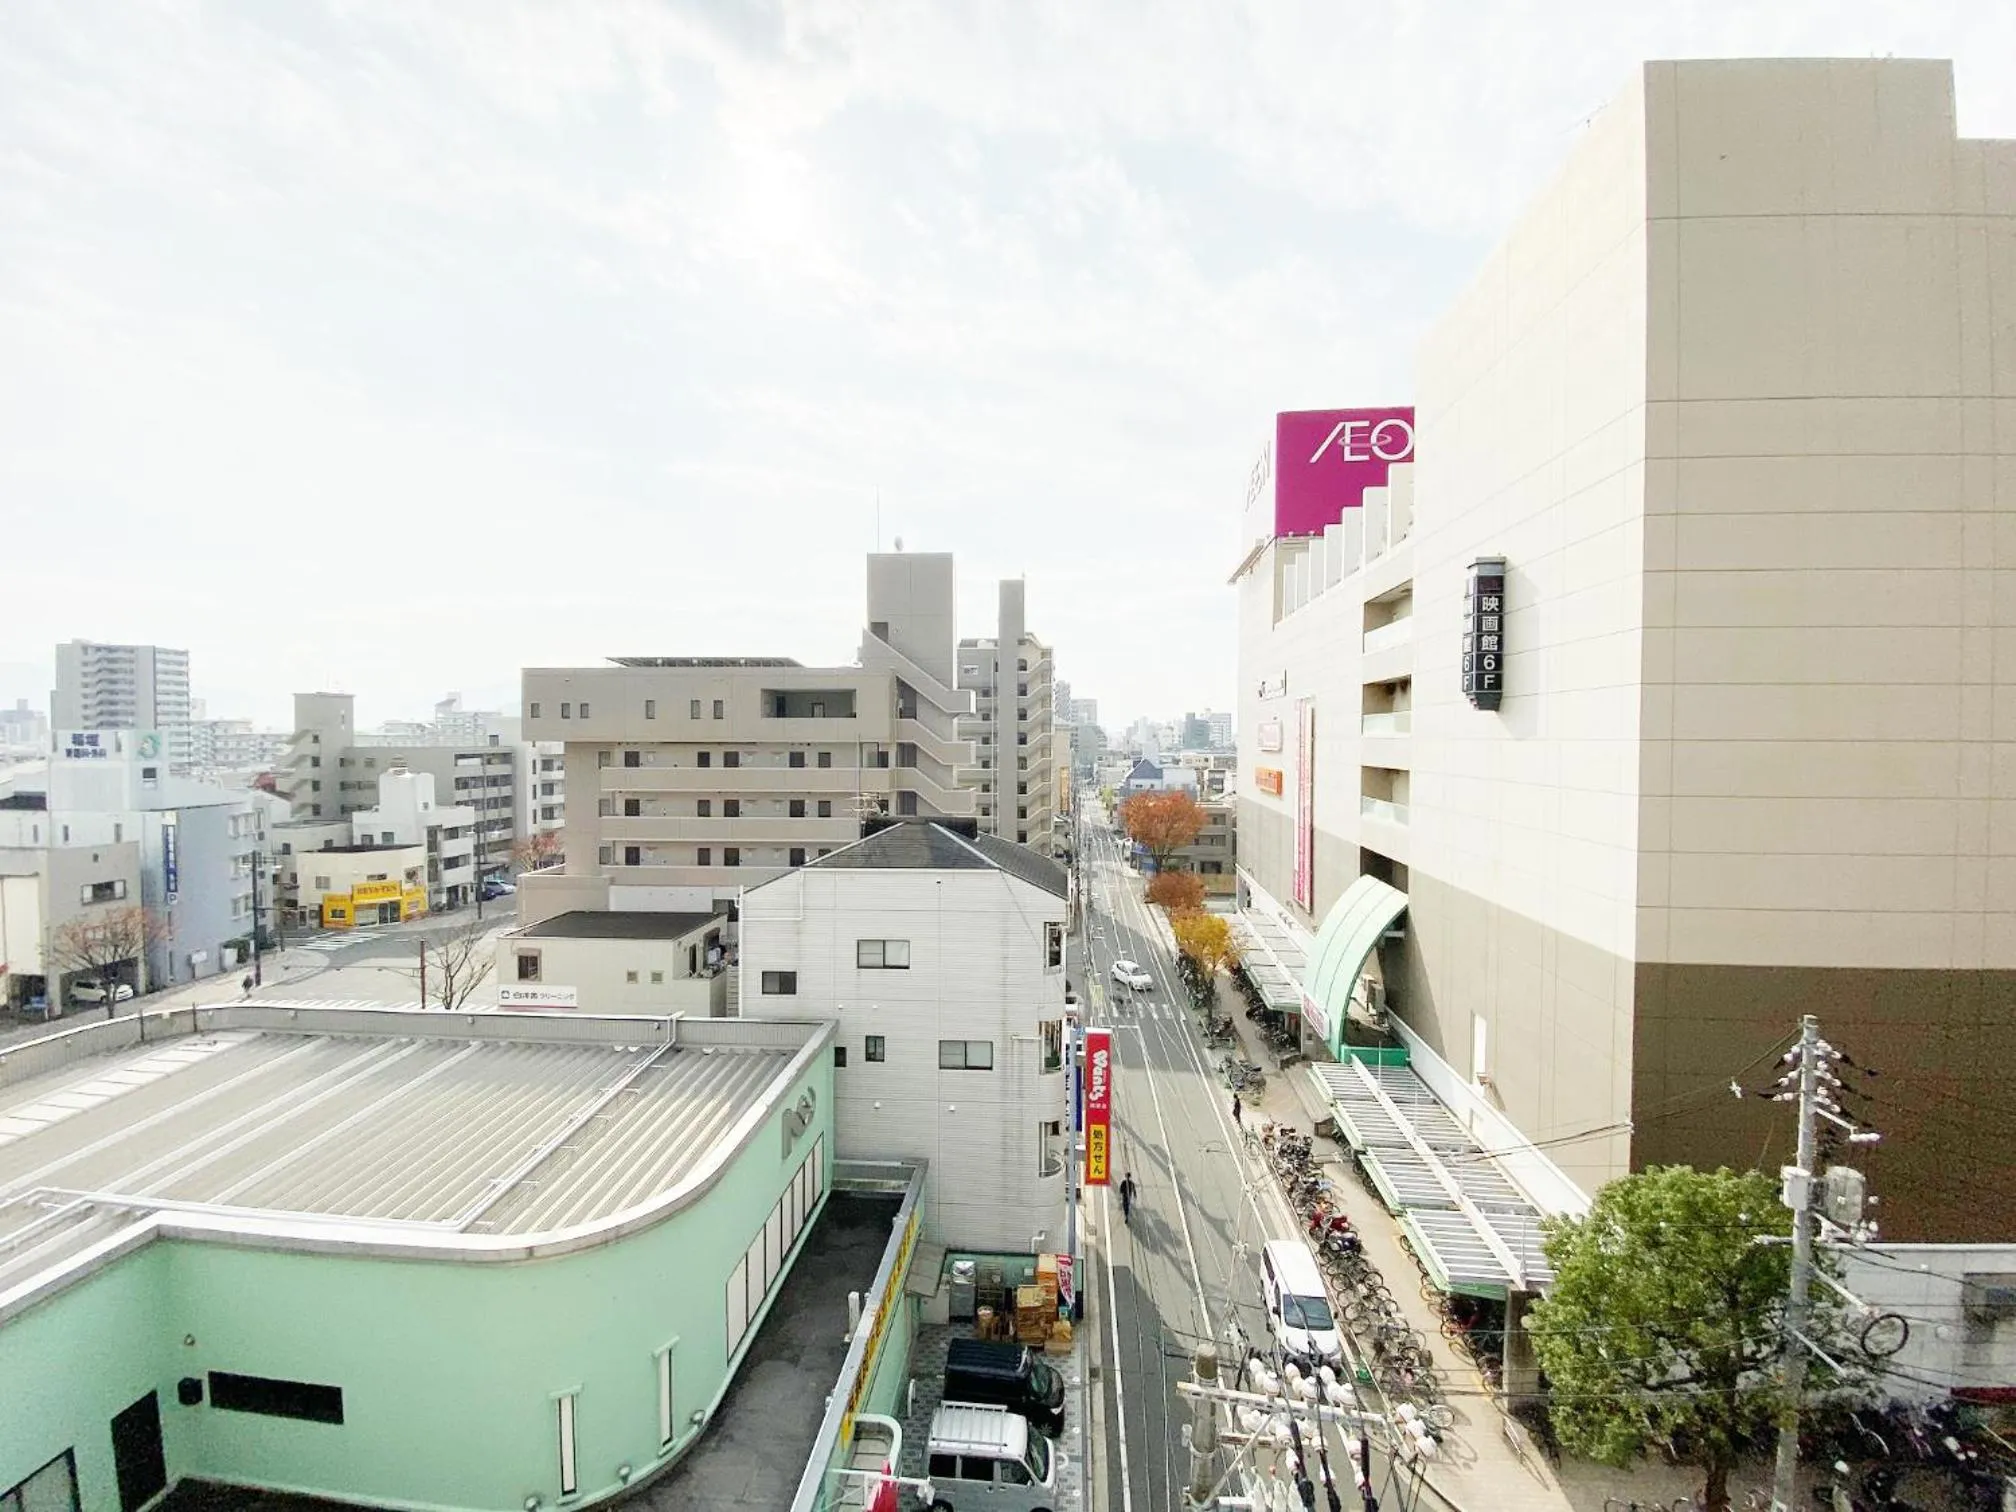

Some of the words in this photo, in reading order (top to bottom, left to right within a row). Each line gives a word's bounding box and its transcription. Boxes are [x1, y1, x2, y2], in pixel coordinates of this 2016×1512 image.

[1480, 595, 1501, 690] 映画館6F
[1092, 1129, 1104, 1175] 処方せん
